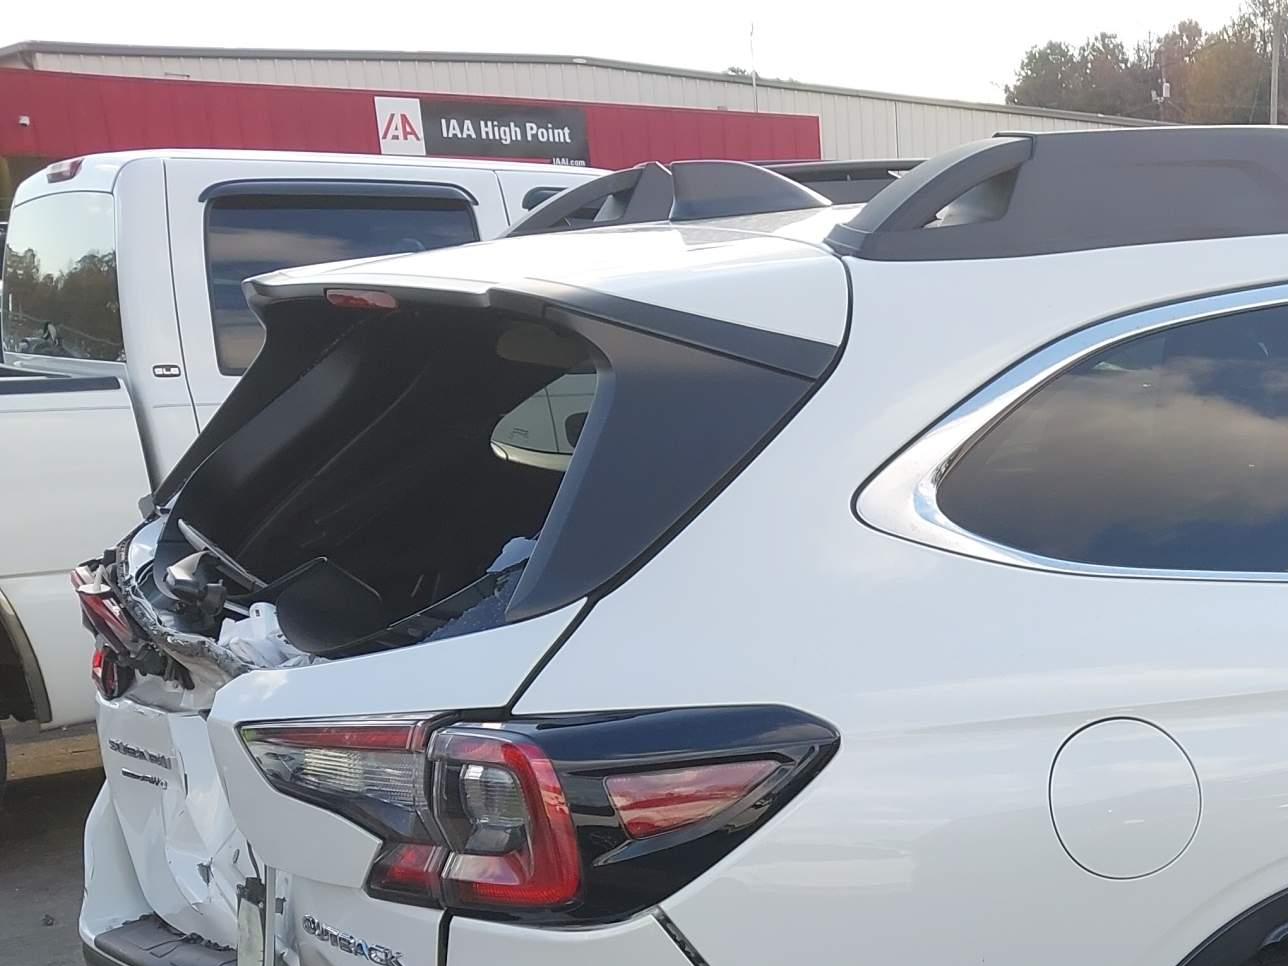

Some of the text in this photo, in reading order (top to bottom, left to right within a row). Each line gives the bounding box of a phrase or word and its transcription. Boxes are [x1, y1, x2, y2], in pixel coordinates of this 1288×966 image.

[440, 118, 571, 144] IAA High Point
